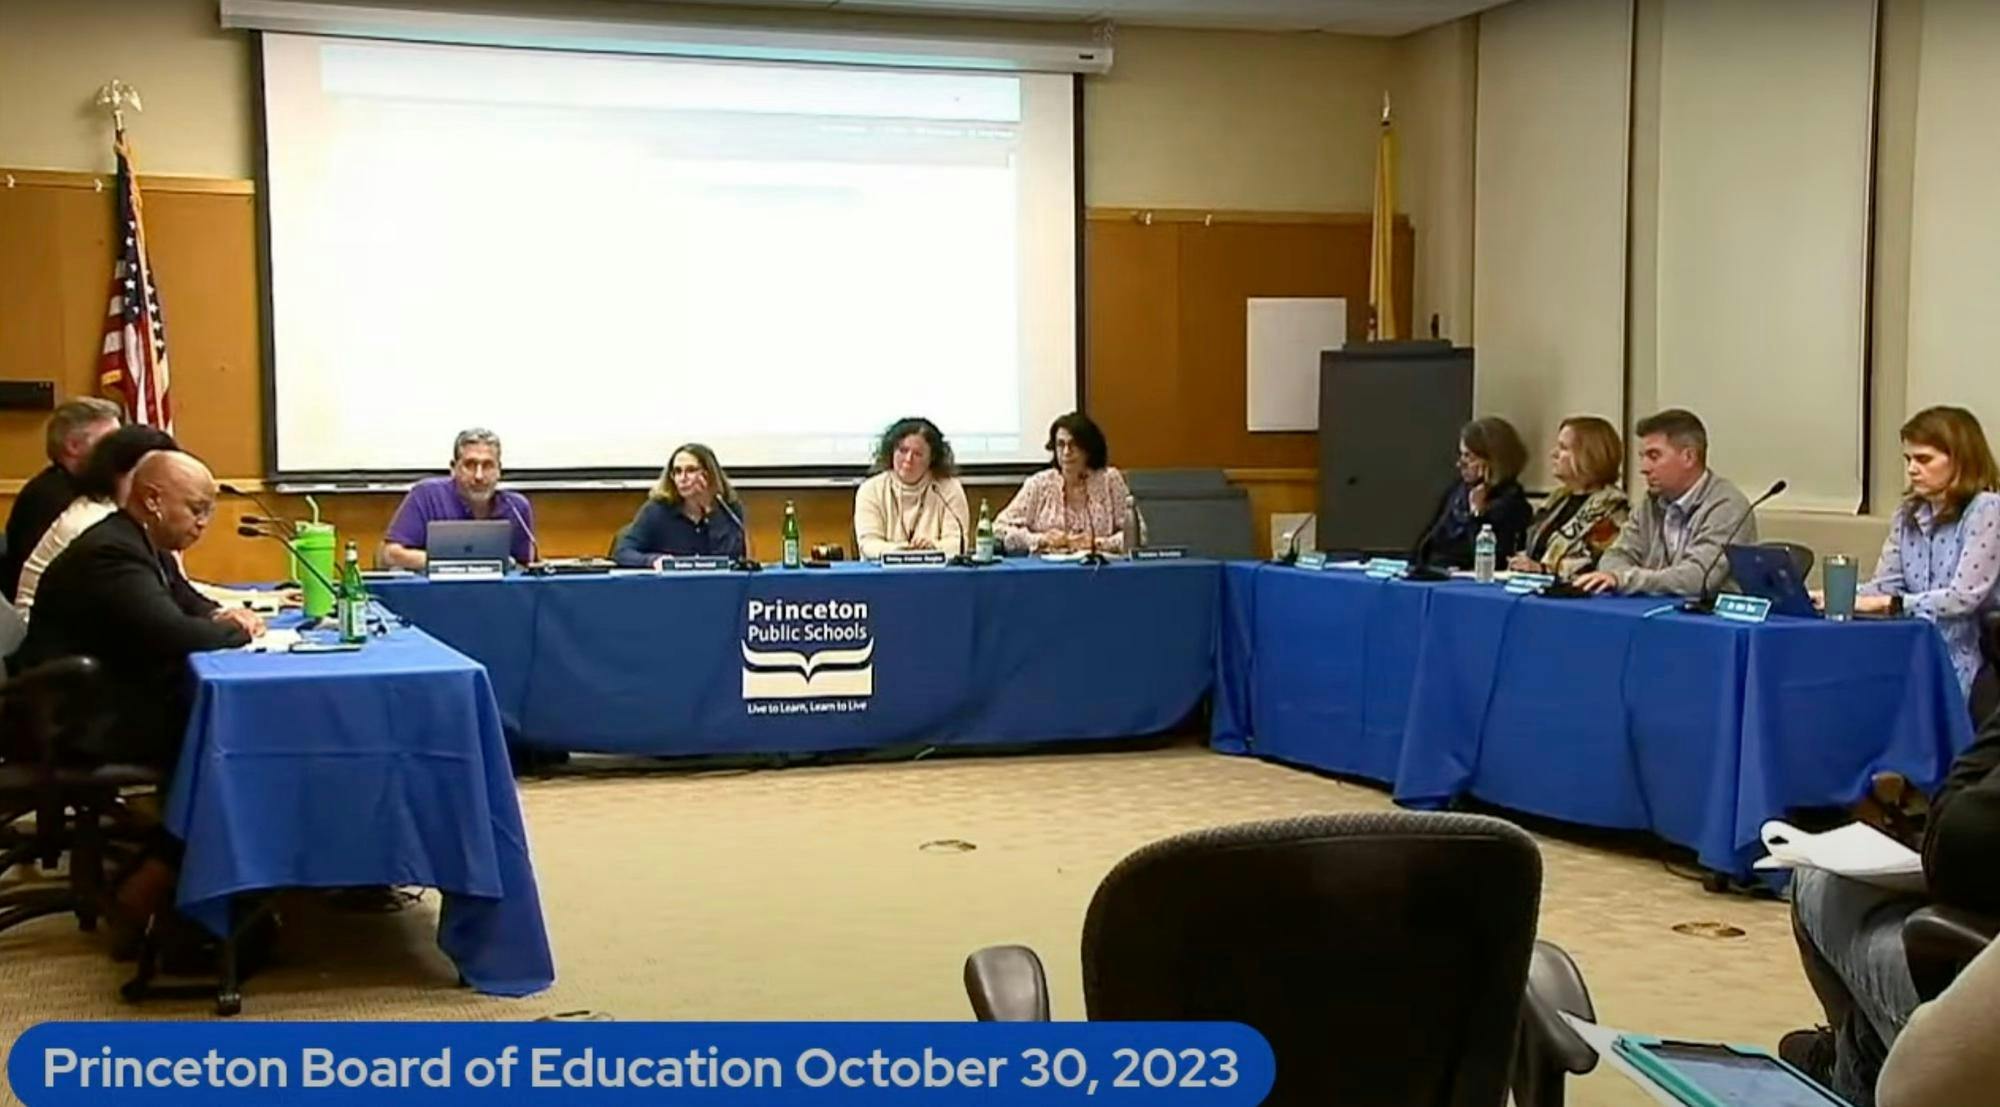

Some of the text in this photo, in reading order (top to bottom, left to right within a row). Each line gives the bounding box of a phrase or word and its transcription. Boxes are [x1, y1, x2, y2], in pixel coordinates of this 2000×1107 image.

[748, 599, 868, 621] Princeton
[748, 622, 868, 642] Public Schools
[747, 700, 867, 714] Live to Learn, Learn to Live
